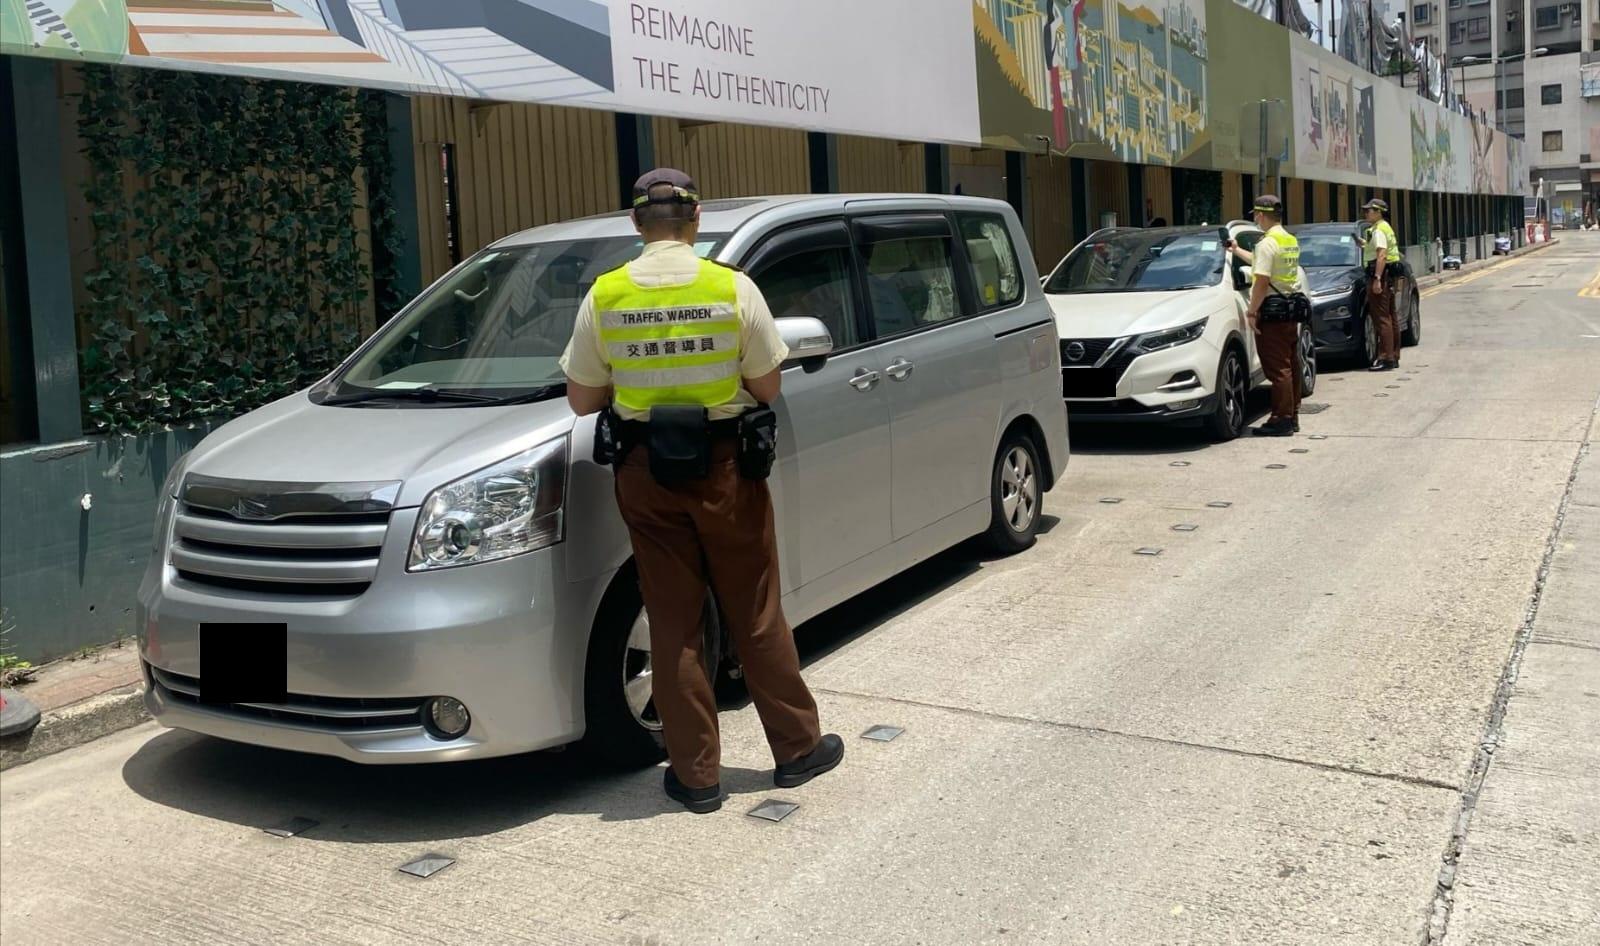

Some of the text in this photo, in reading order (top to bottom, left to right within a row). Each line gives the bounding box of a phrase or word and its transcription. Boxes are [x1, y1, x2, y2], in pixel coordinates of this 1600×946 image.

[630, 3, 755, 57] REIMAGINE
[632, 56, 830, 113] THE AUTHENTICITY
[622, 308, 712, 325] TRAFFIC WARDEN
[626, 337, 715, 358] 交通督導員
